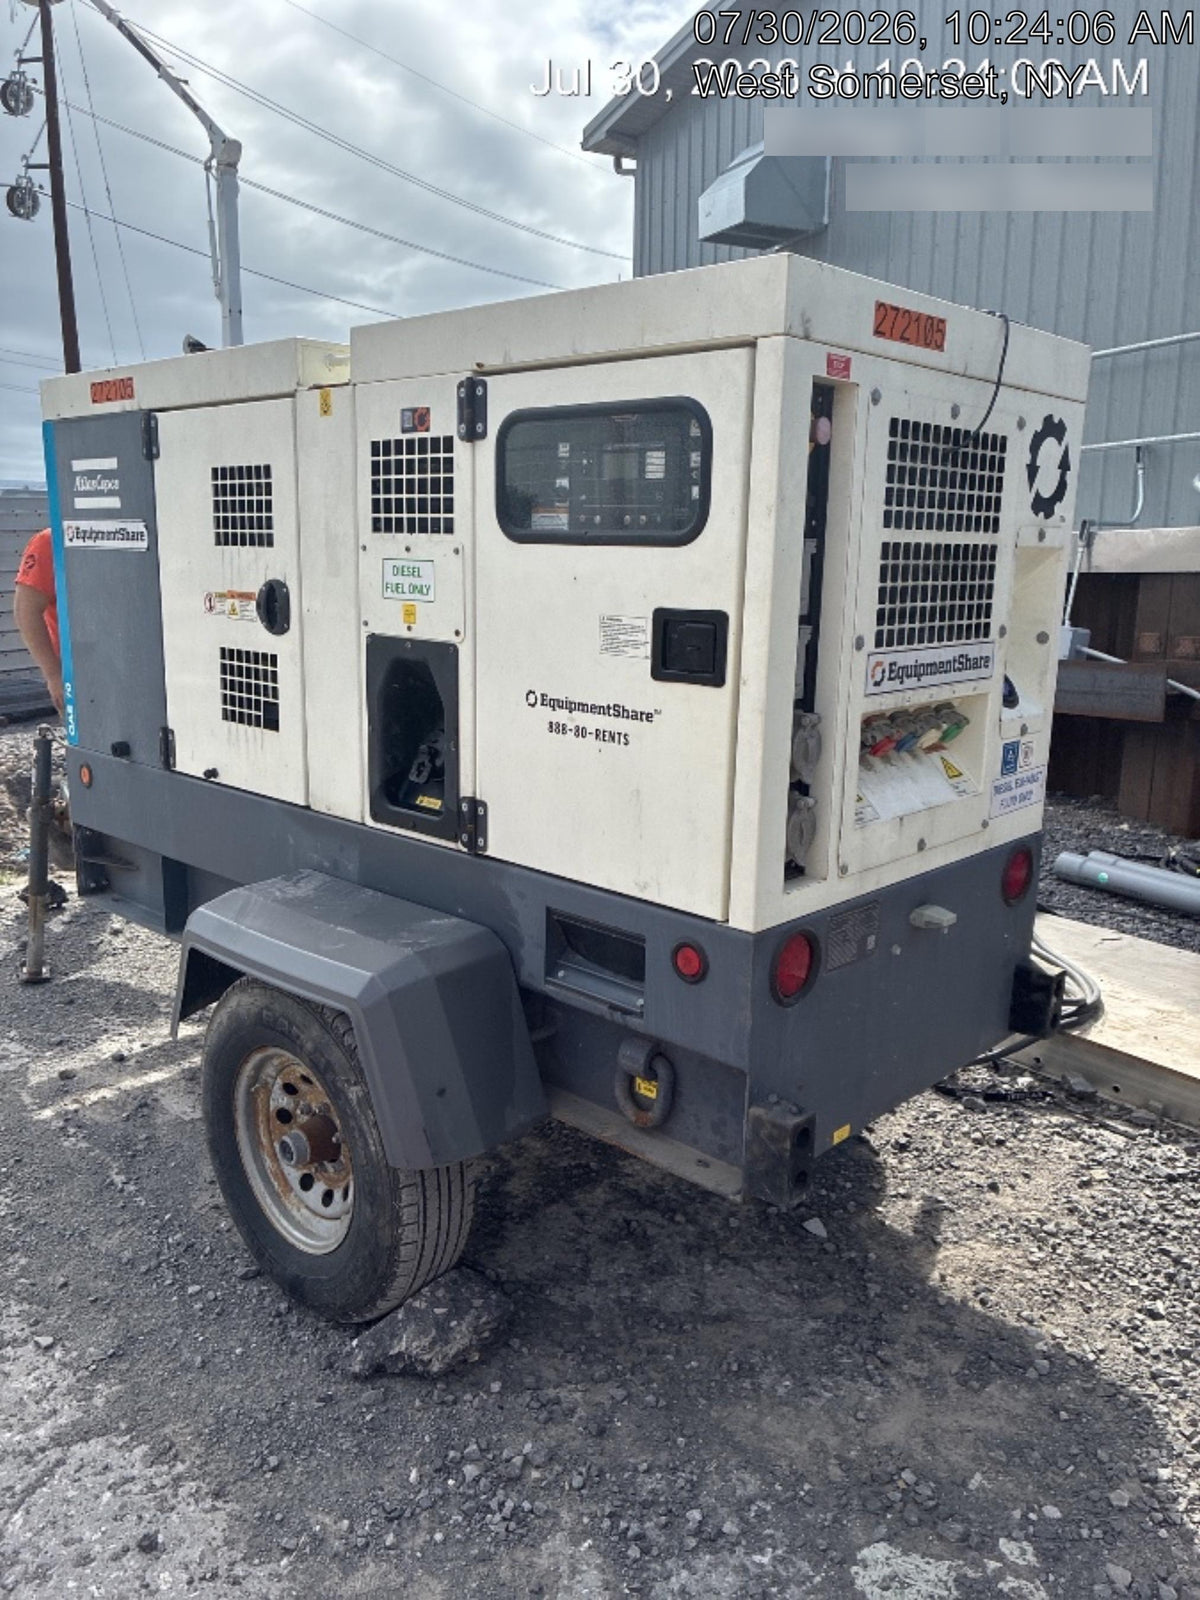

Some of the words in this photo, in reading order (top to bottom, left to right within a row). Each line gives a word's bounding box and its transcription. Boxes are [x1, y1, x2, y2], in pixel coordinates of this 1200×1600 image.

[874, 301, 945, 351] 272105
[74, 526, 146, 543] EquipmentShare
[392, 564, 422, 578] DIESEL
[385, 582, 406, 595] FUEL
[408, 582, 431, 596] ONLY
[886, 653, 991, 685] EquipmentShare
[540, 692, 654, 723] EquipmentShare
[547, 720, 630, 747] 888-80-RENTS
